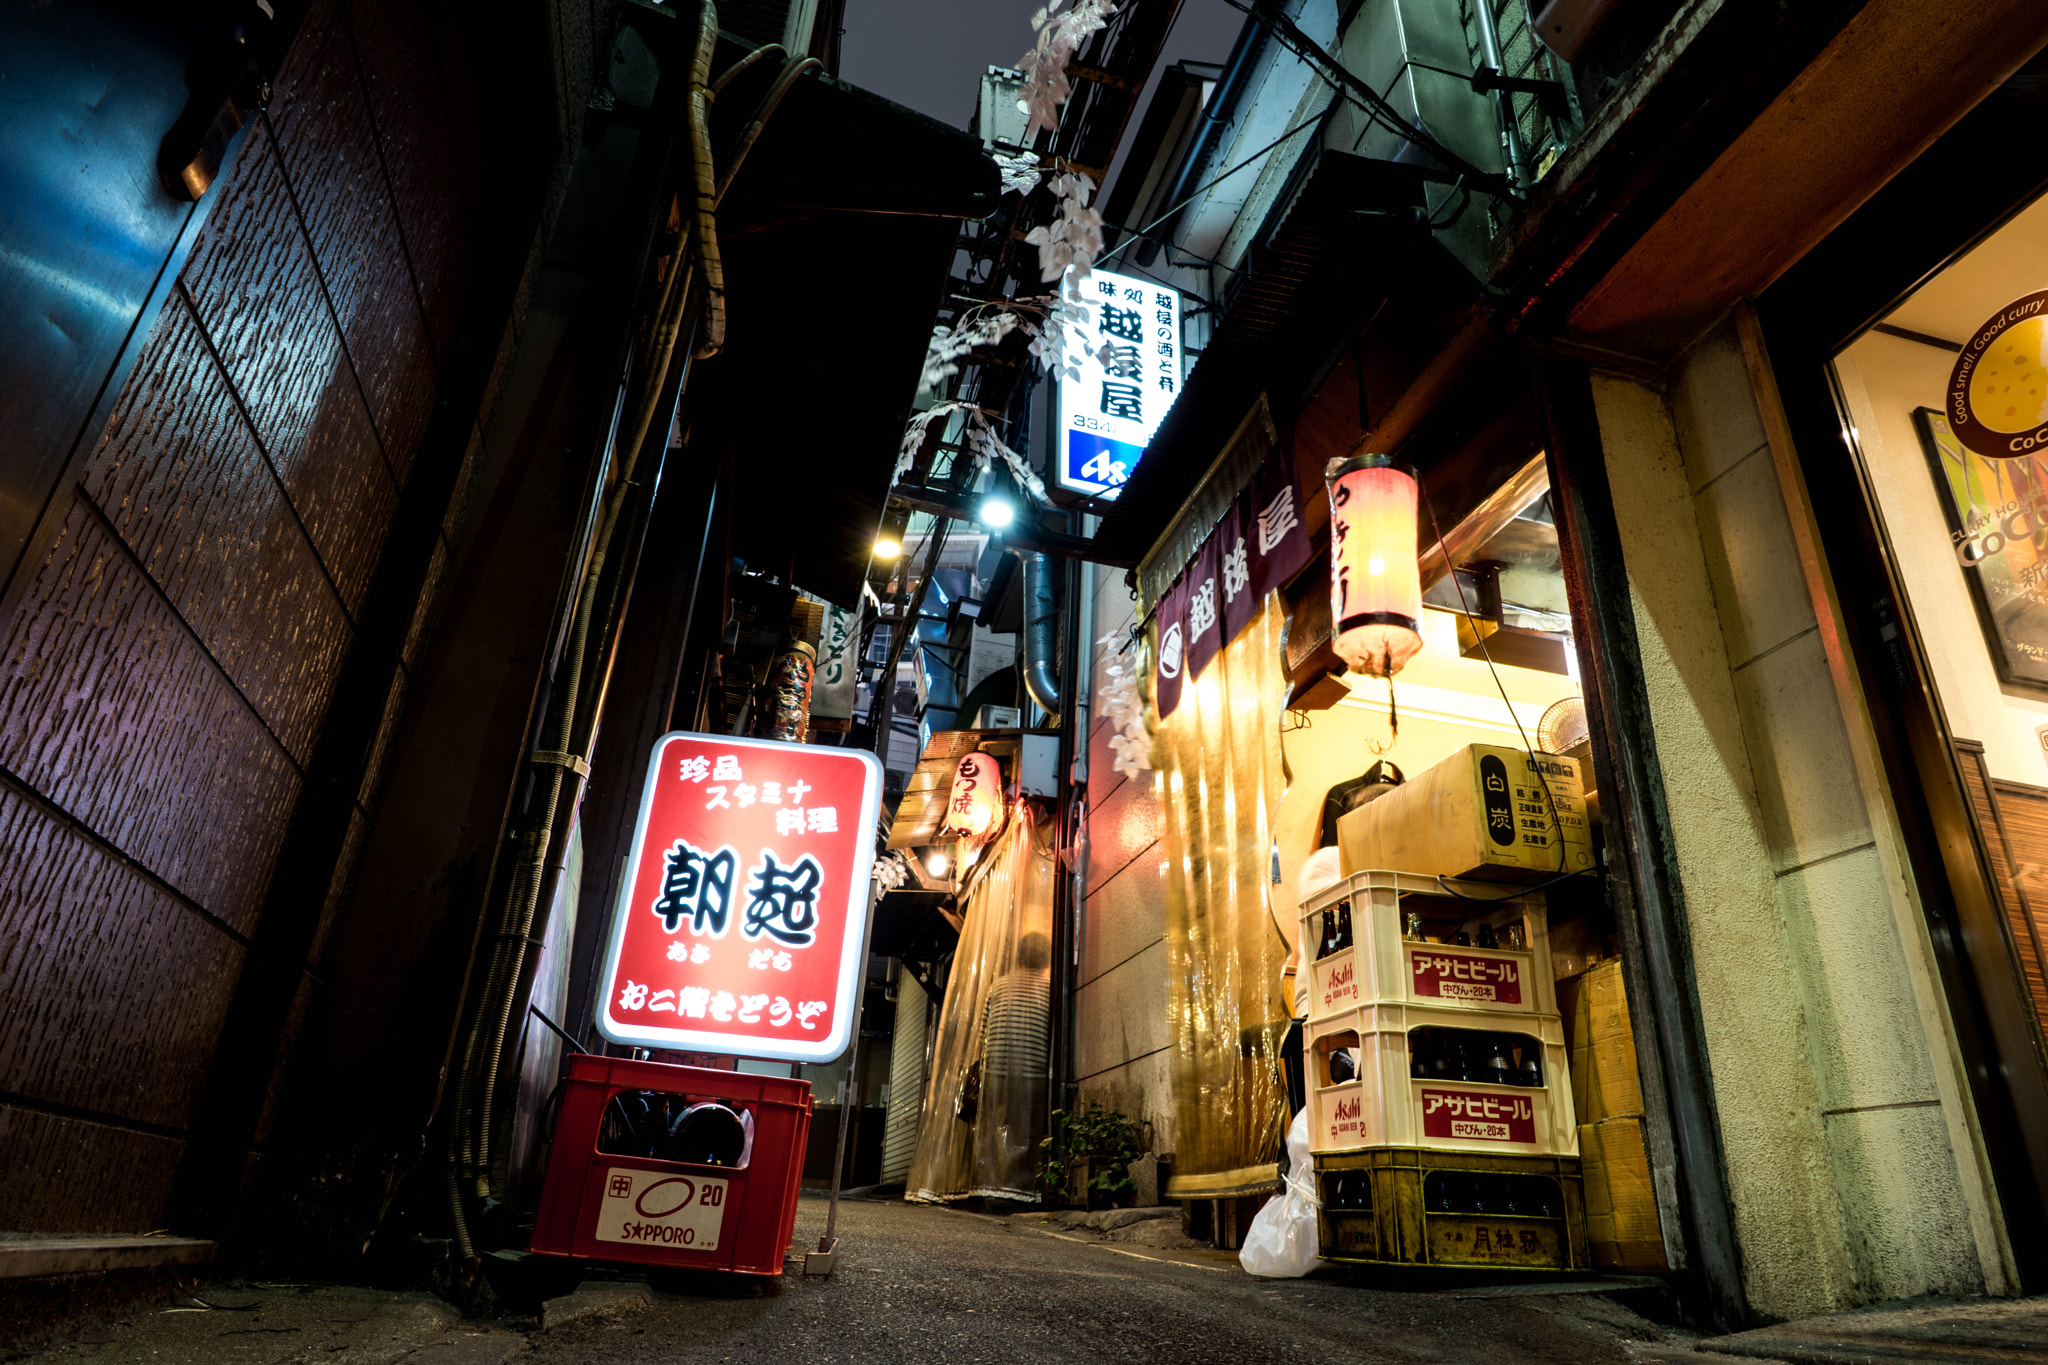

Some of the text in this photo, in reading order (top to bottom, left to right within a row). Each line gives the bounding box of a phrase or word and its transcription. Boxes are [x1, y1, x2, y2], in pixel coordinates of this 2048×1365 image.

[1098, 281, 1143, 304] 味処
[1952, 298, 2045, 425] Good smell. Good curry
[1950, 513, 1991, 543] CURRY
[2019, 557, 2048, 588] 新
[679, 755, 742, 783] 珍品
[705, 779, 811, 810] スタミナ
[1486, 772, 1512, 830] 白炭
[776, 807, 838, 835] 料理
[1521, 818, 1546, 830] 生産地
[1523, 833, 1548, 845] 生産者
[1328, 962, 1353, 990] Asahi
[1414, 956, 1517, 983] アサヒビール
[1334, 1096, 1361, 1121] Asahi
[1424, 1094, 1531, 1121] アサヒビール
[610, 1176, 723, 1207] 中 20
[1473, 1226, 1539, 1254] 月桂冠
